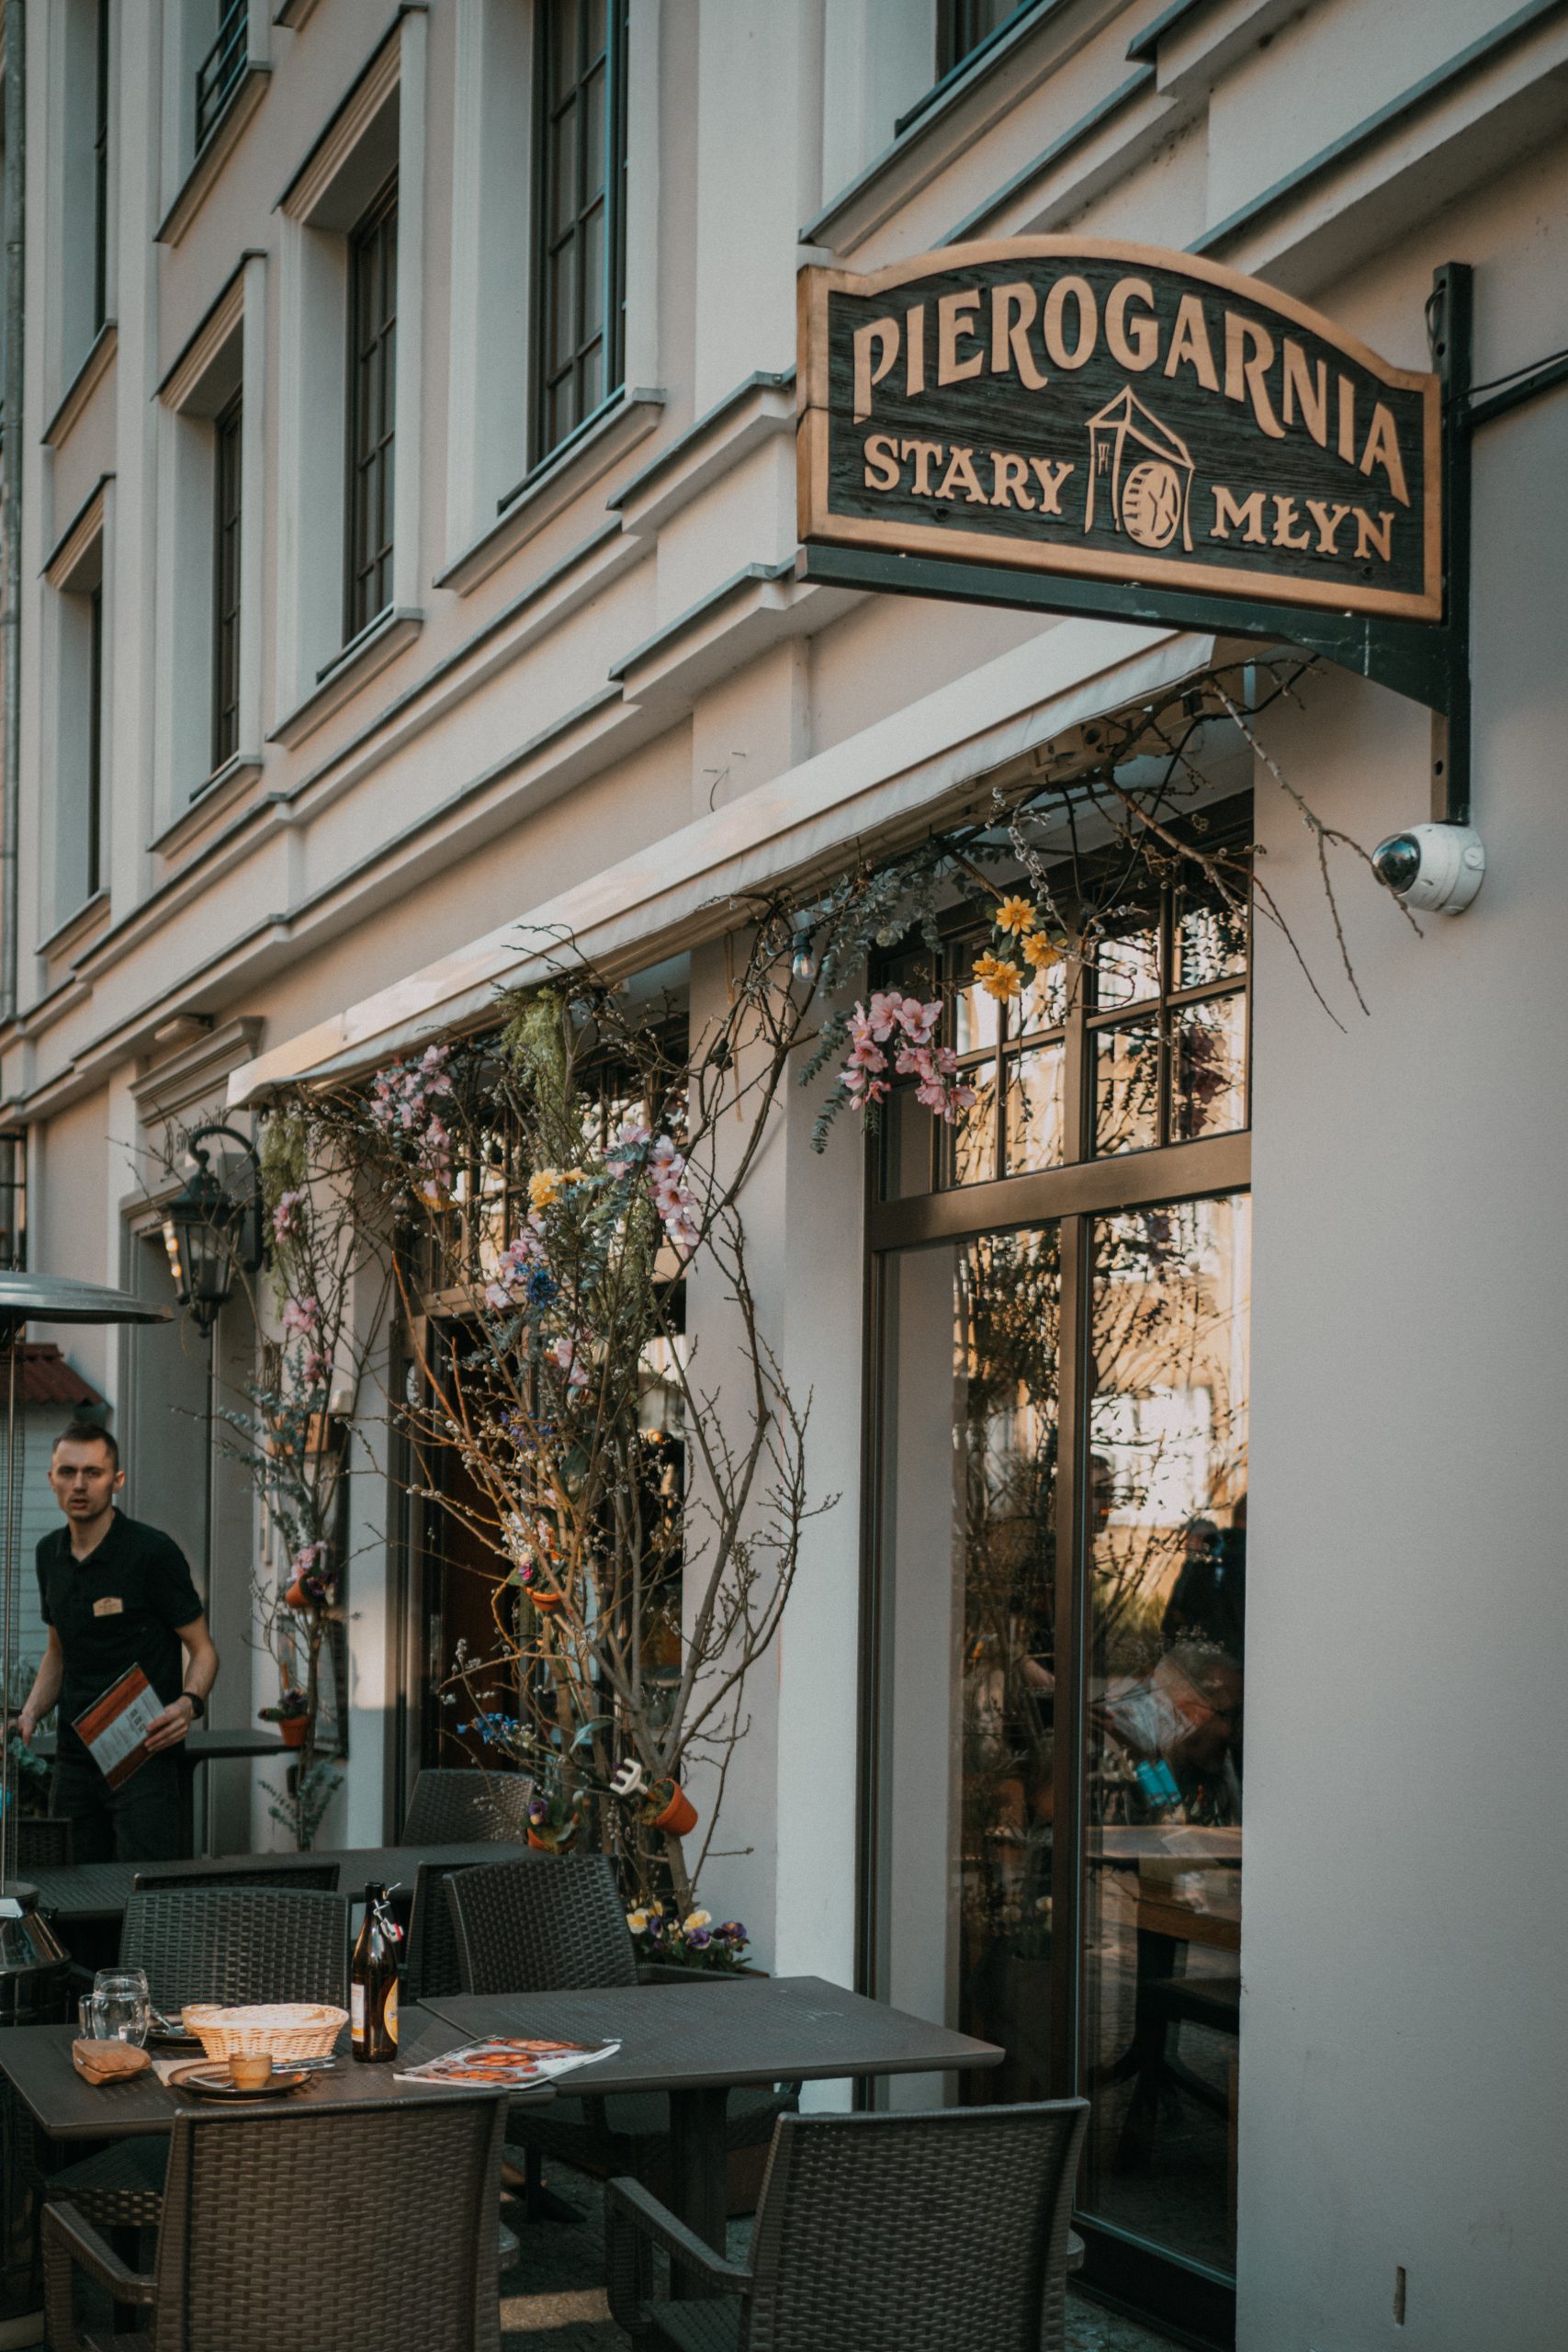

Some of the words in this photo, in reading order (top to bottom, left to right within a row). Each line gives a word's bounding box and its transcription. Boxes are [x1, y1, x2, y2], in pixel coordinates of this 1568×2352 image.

[852, 276, 1410, 507] PIEROGARNIA
[863, 435, 1074, 514] STARY
[1210, 486, 1395, 561] MŁYN
